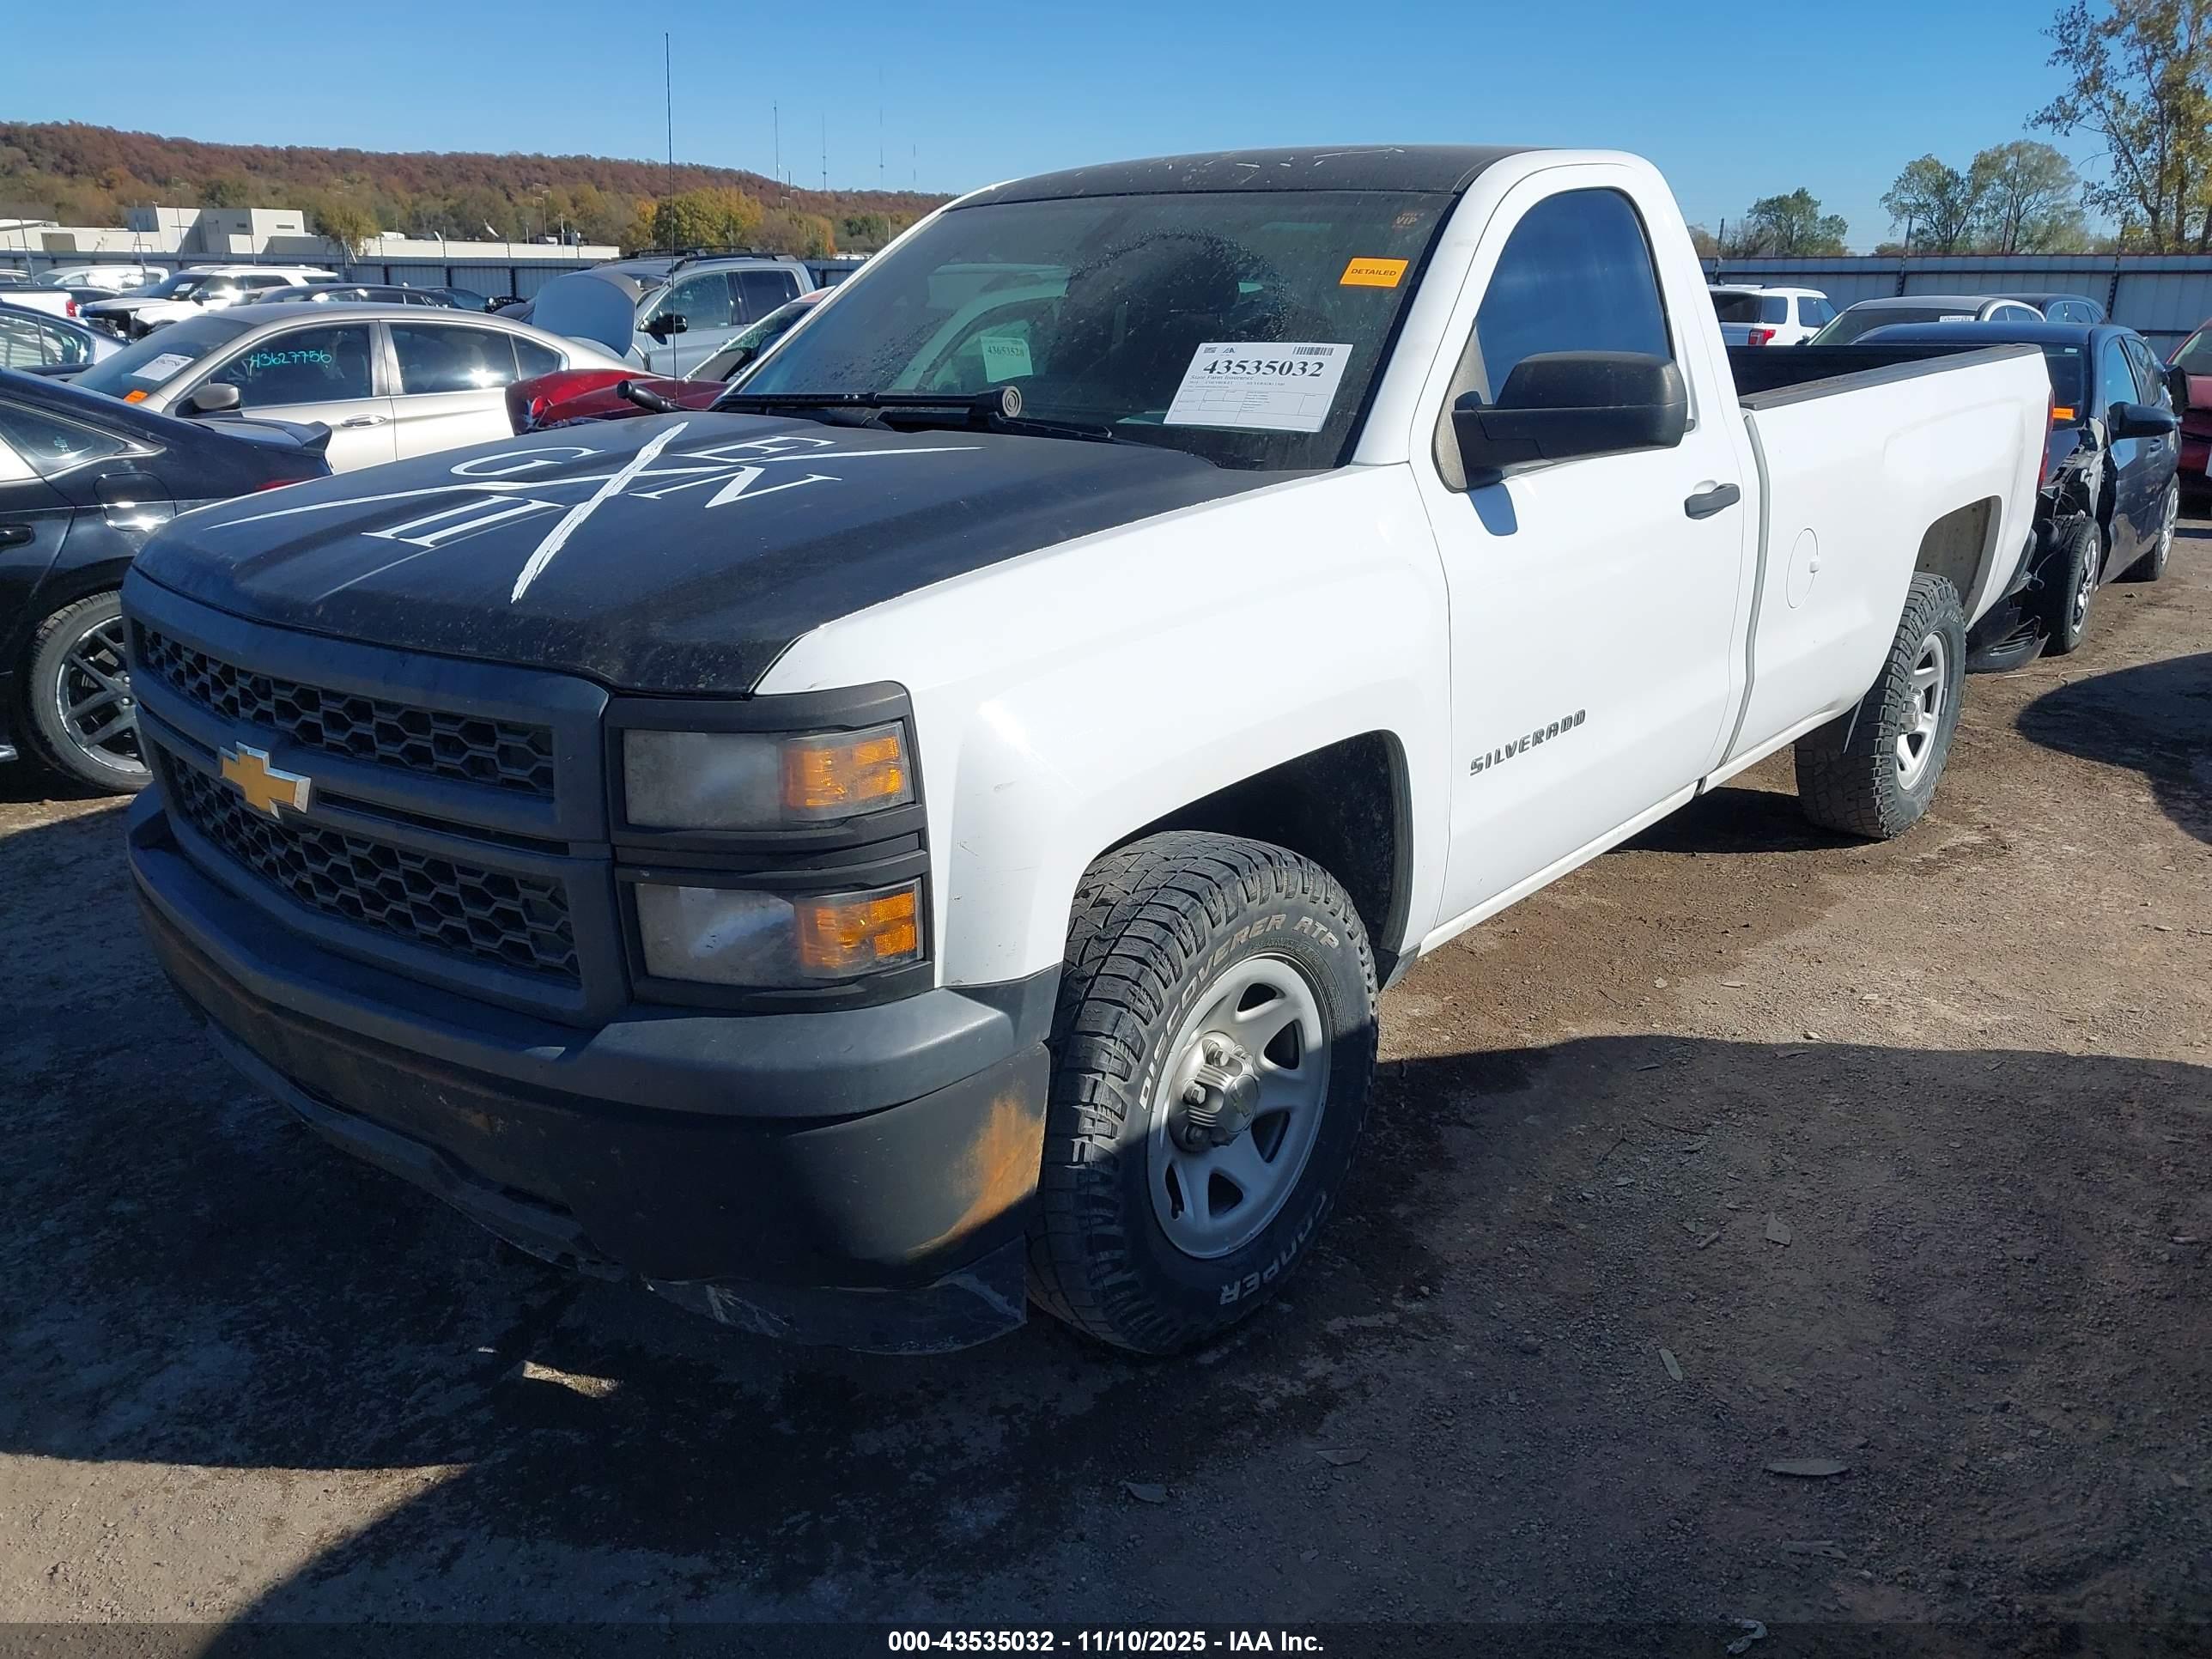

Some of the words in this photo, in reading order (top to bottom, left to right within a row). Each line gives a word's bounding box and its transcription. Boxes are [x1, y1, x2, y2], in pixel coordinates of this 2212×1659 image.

[1351, 267, 1396, 276] DETAILED
[251, 350, 331, 368] 43627756
[1203, 359, 1325, 378] 43535032
[1470, 708, 1586, 776] SILVERADO
[1139, 915, 1287, 1110] DISCOVERER
[1291, 916, 1340, 949] ATP
